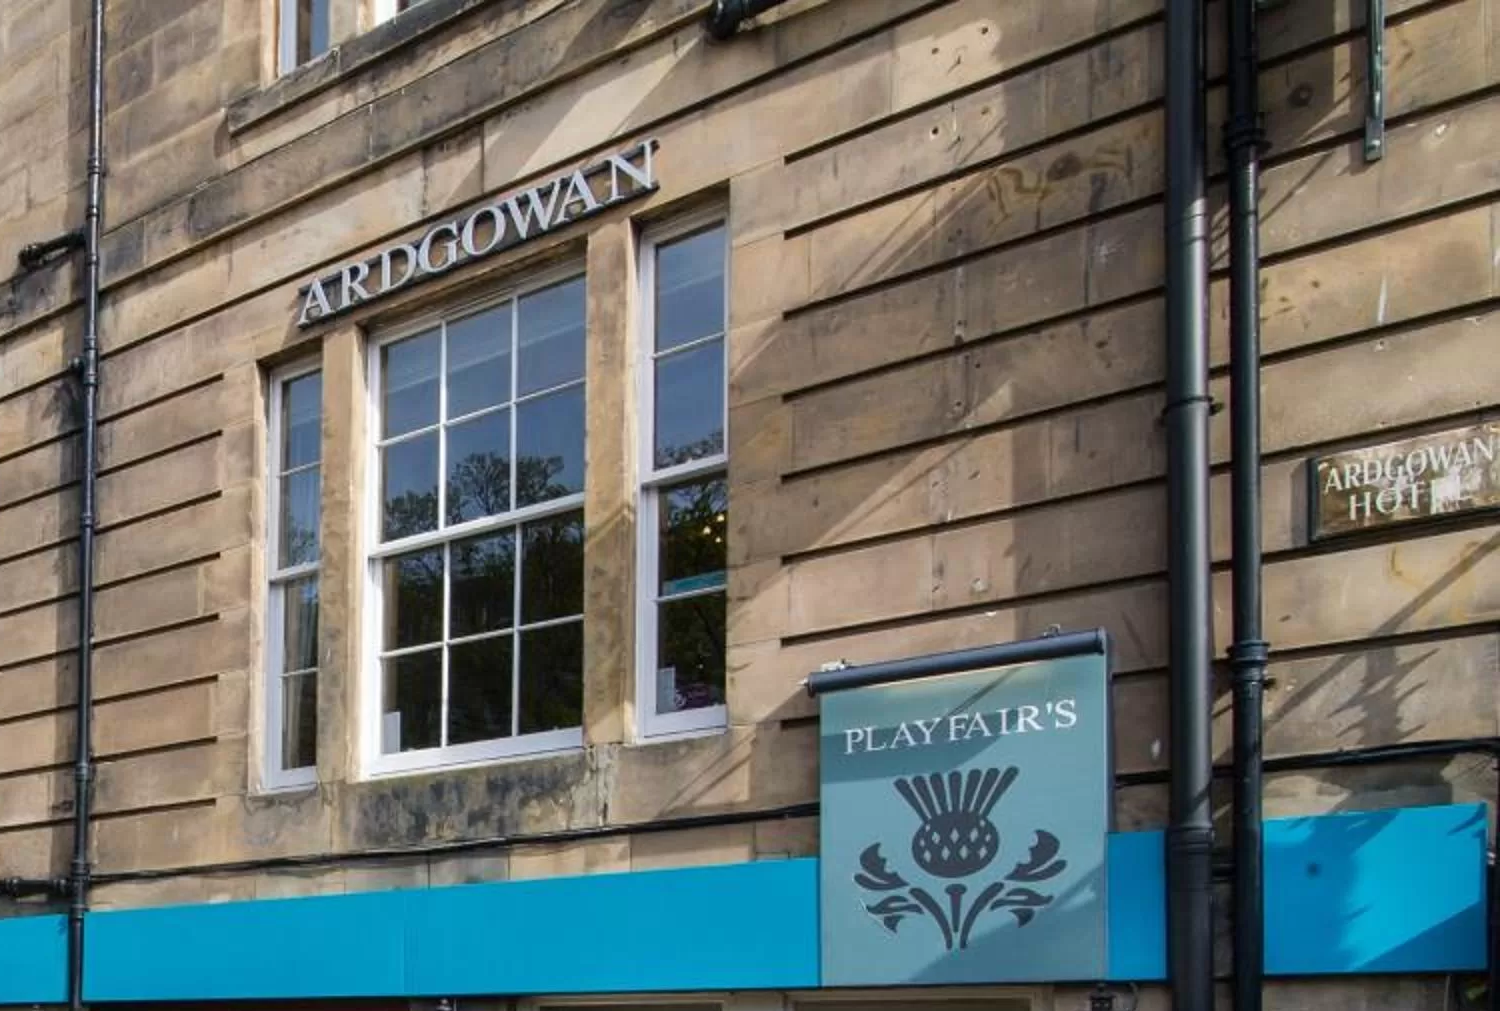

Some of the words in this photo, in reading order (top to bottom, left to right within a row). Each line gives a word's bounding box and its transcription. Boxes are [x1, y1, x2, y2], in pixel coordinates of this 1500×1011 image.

[297, 138, 660, 328] ARDGOWAN
[1324, 435, 1499, 496] ARDGOWAN
[844, 699, 1077, 754] PLAYFAIR'S
